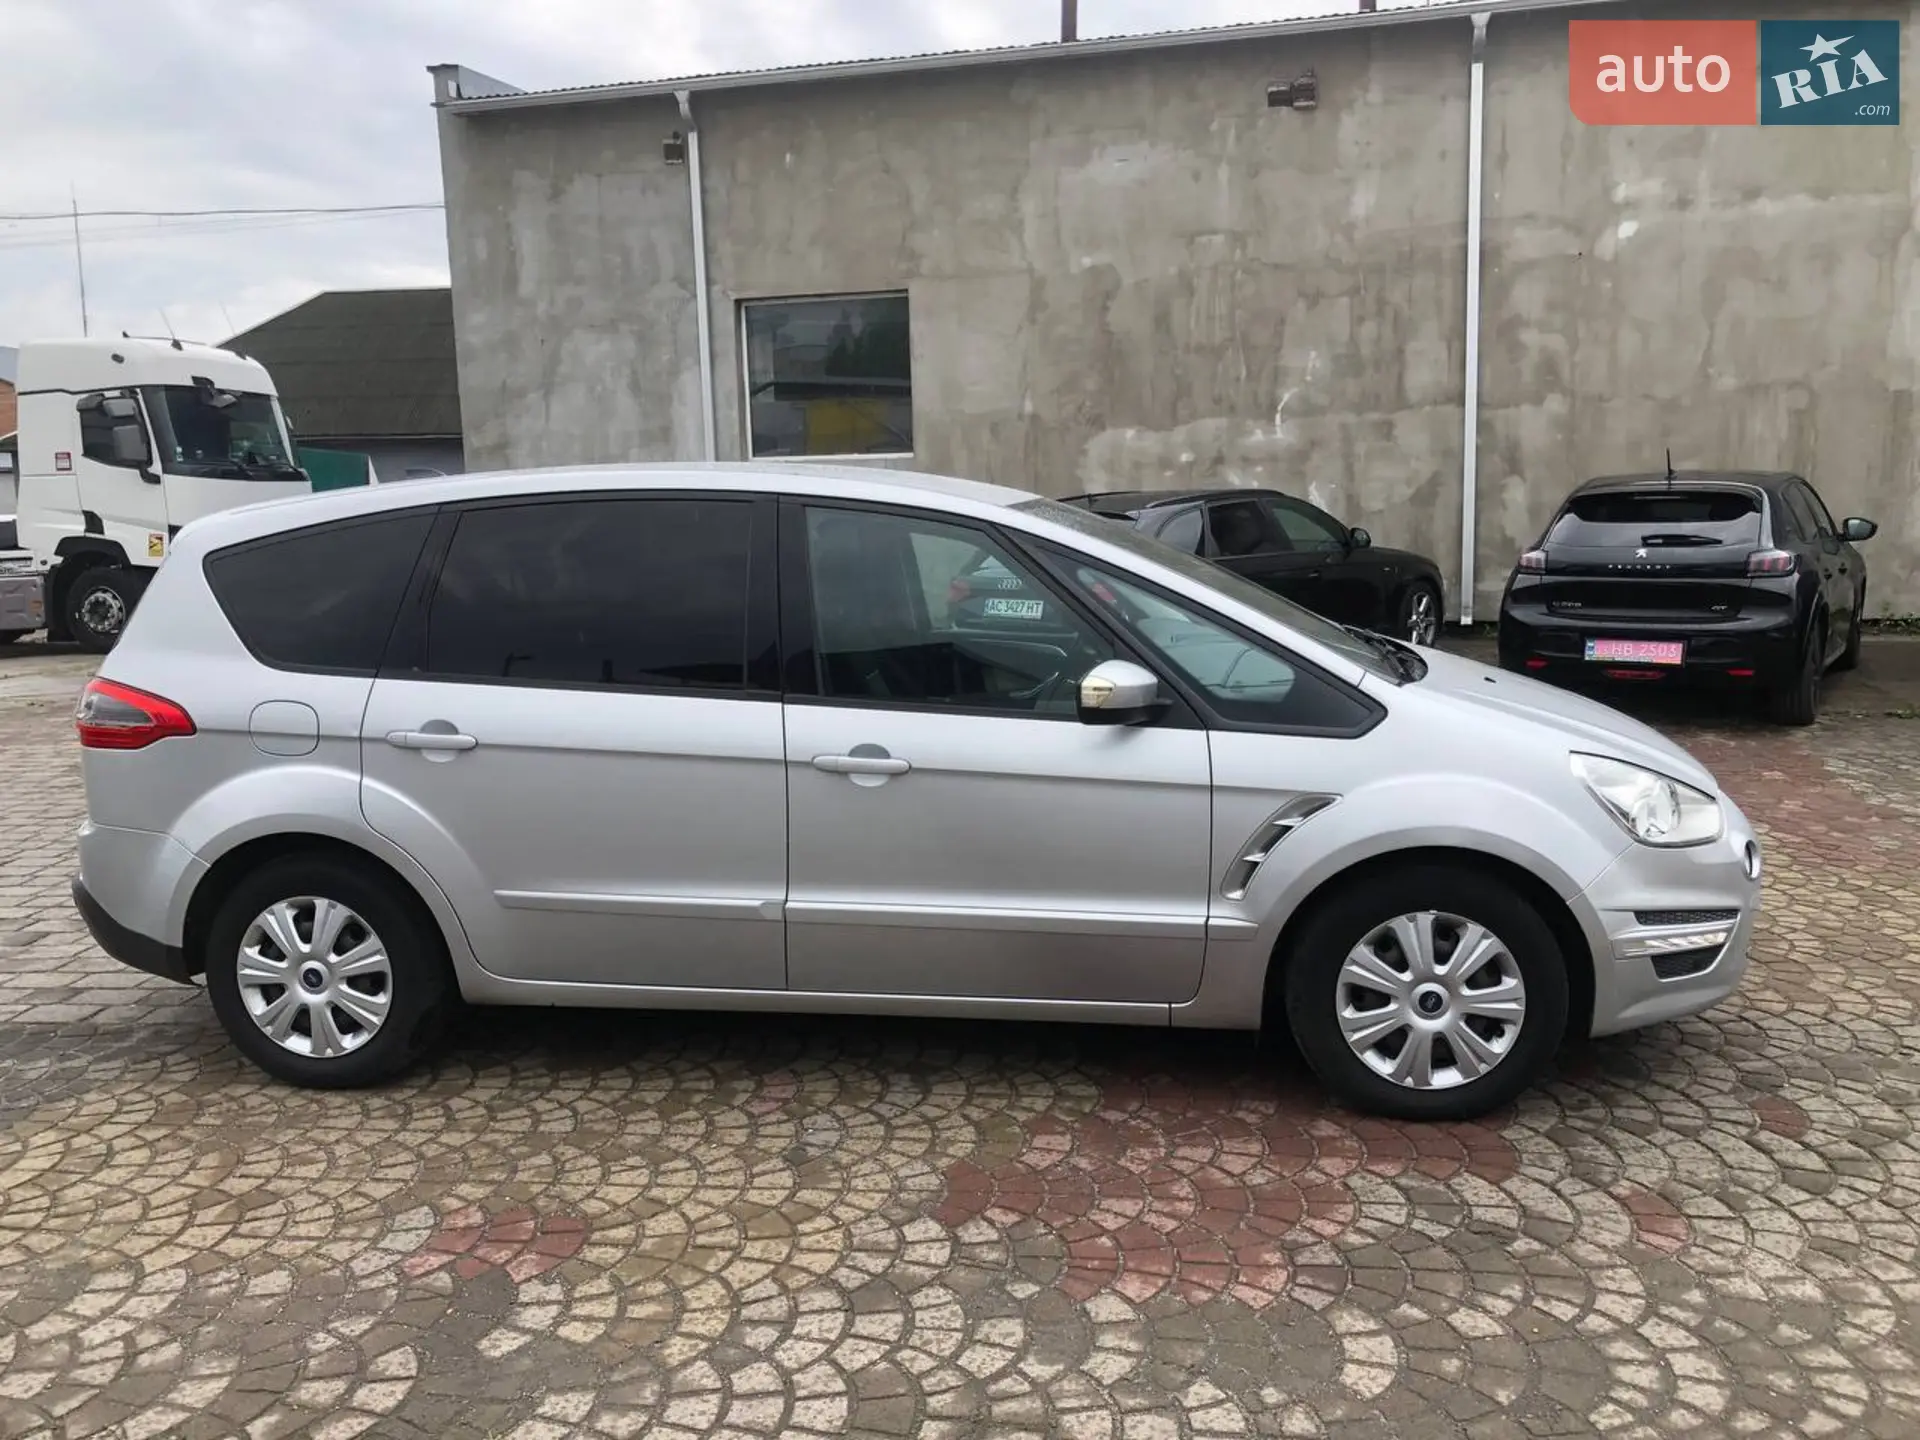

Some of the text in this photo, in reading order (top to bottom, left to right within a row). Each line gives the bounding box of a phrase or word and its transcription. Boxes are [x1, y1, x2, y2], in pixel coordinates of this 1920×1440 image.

[989, 599, 1042, 614] AC 3427 HT
